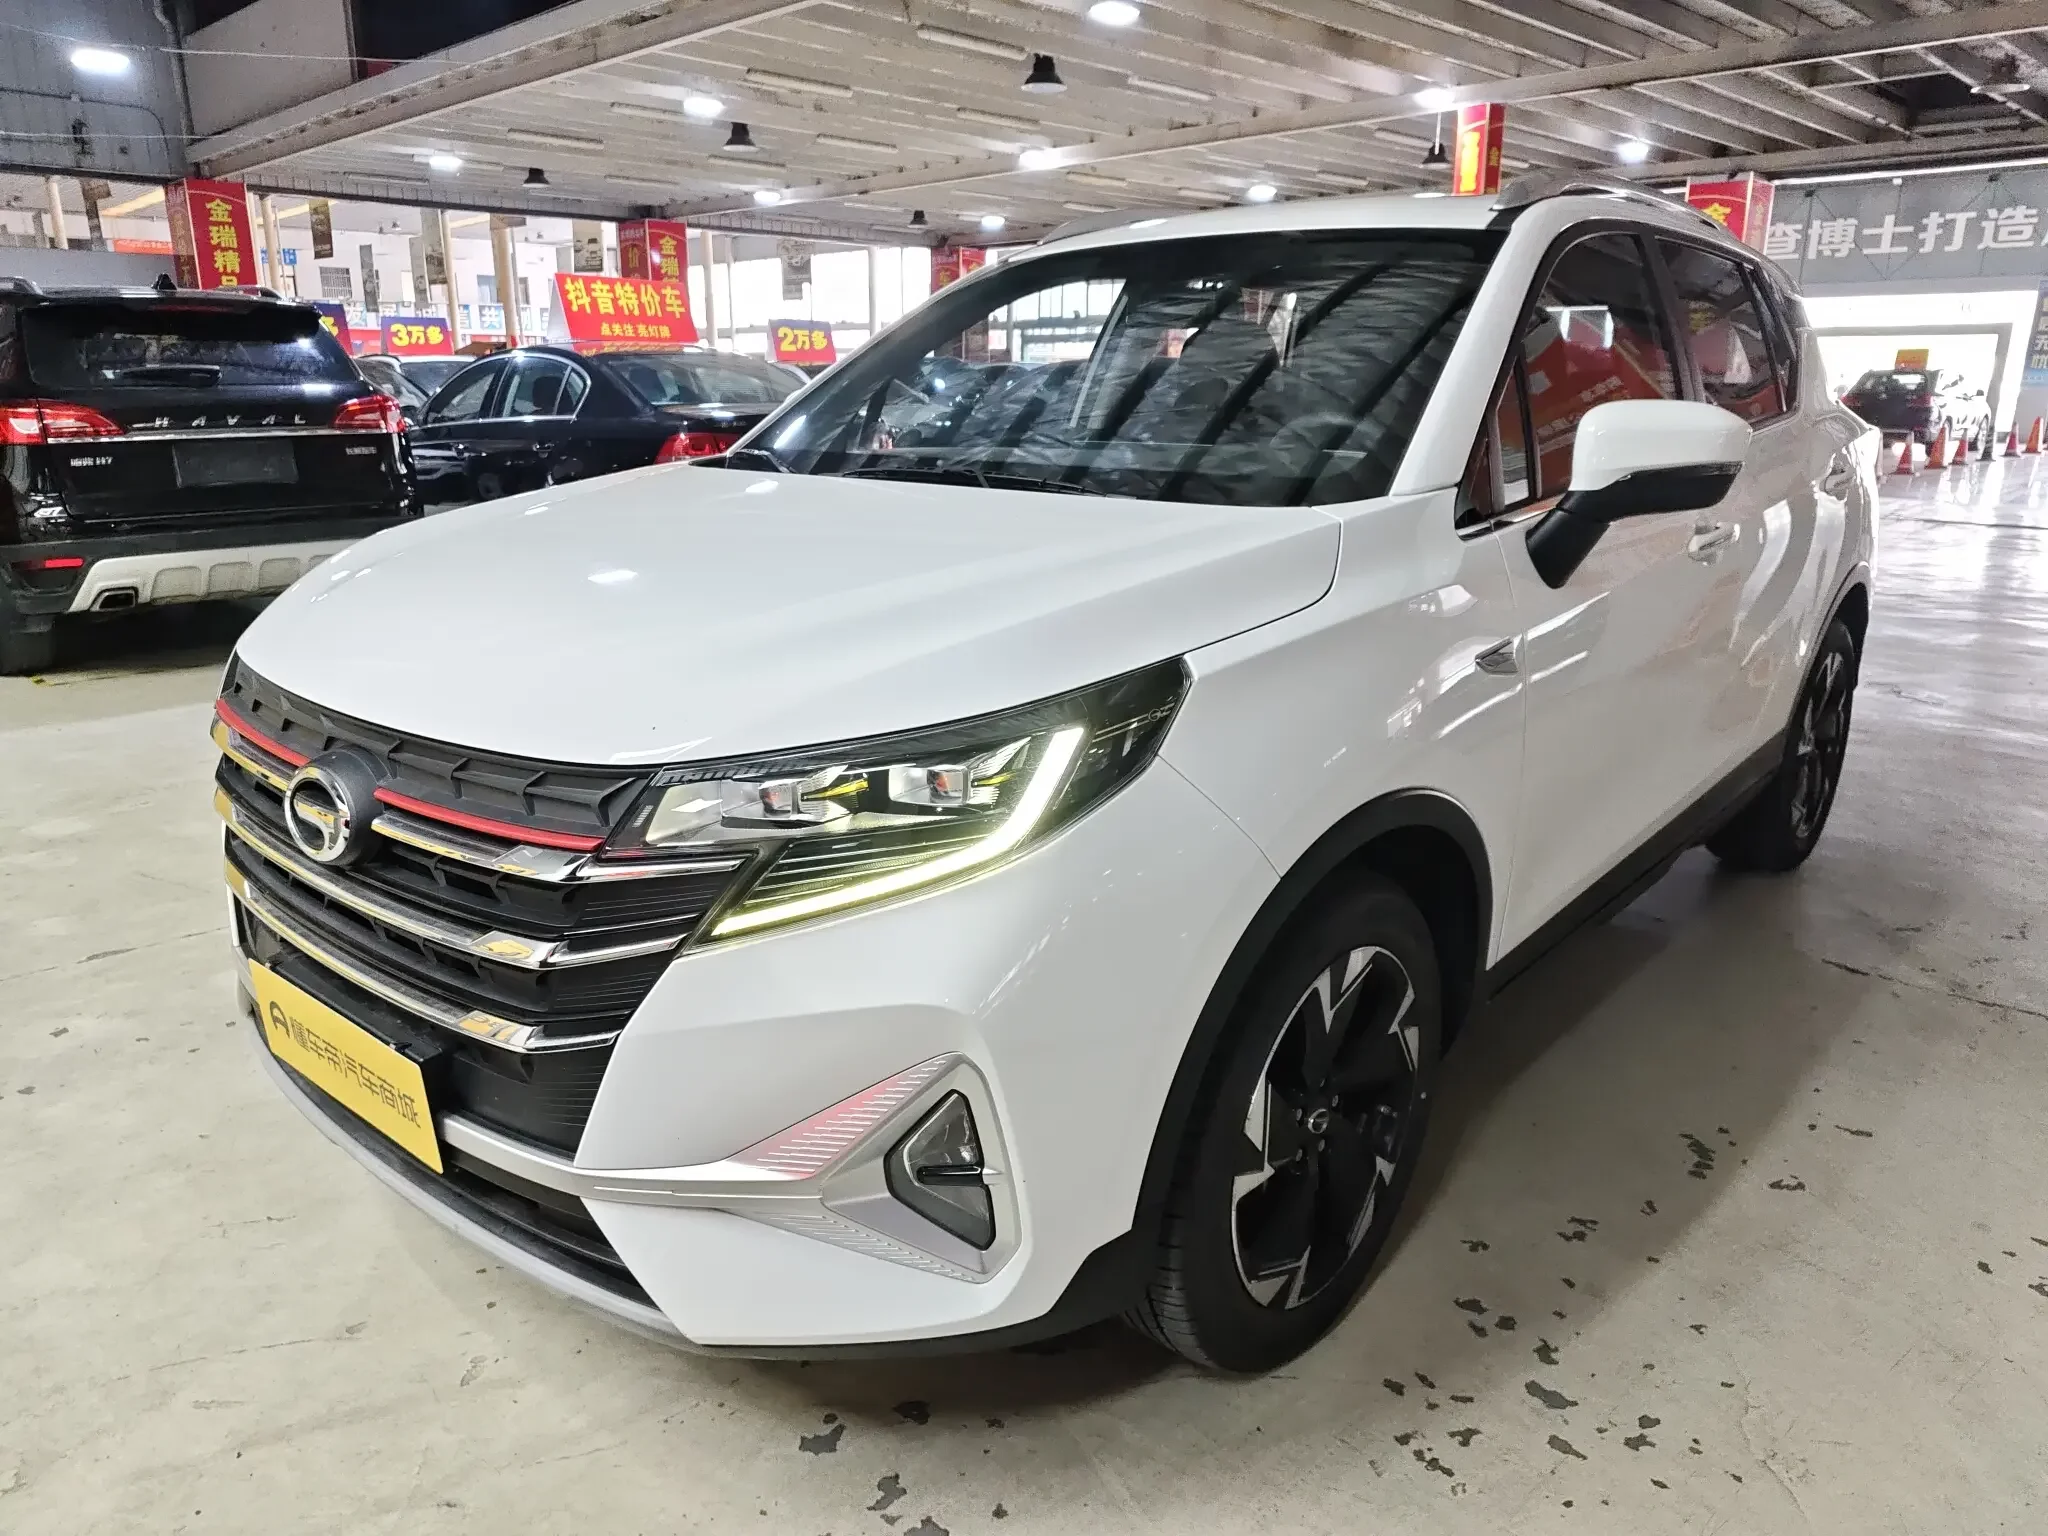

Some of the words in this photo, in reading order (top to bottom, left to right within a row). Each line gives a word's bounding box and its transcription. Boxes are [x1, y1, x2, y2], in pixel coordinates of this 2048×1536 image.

[1766, 205, 2048, 260] 查博士打造
[564, 276, 686, 319] 抖音特价车
[390, 323, 443, 346] 3万多
[601, 322, 635, 337] 点关注
[778, 326, 828, 351] 2万多
[154, 413, 306, 428] HAVAL
[290, 1016, 421, 1128] 懂车帝汽车商城
